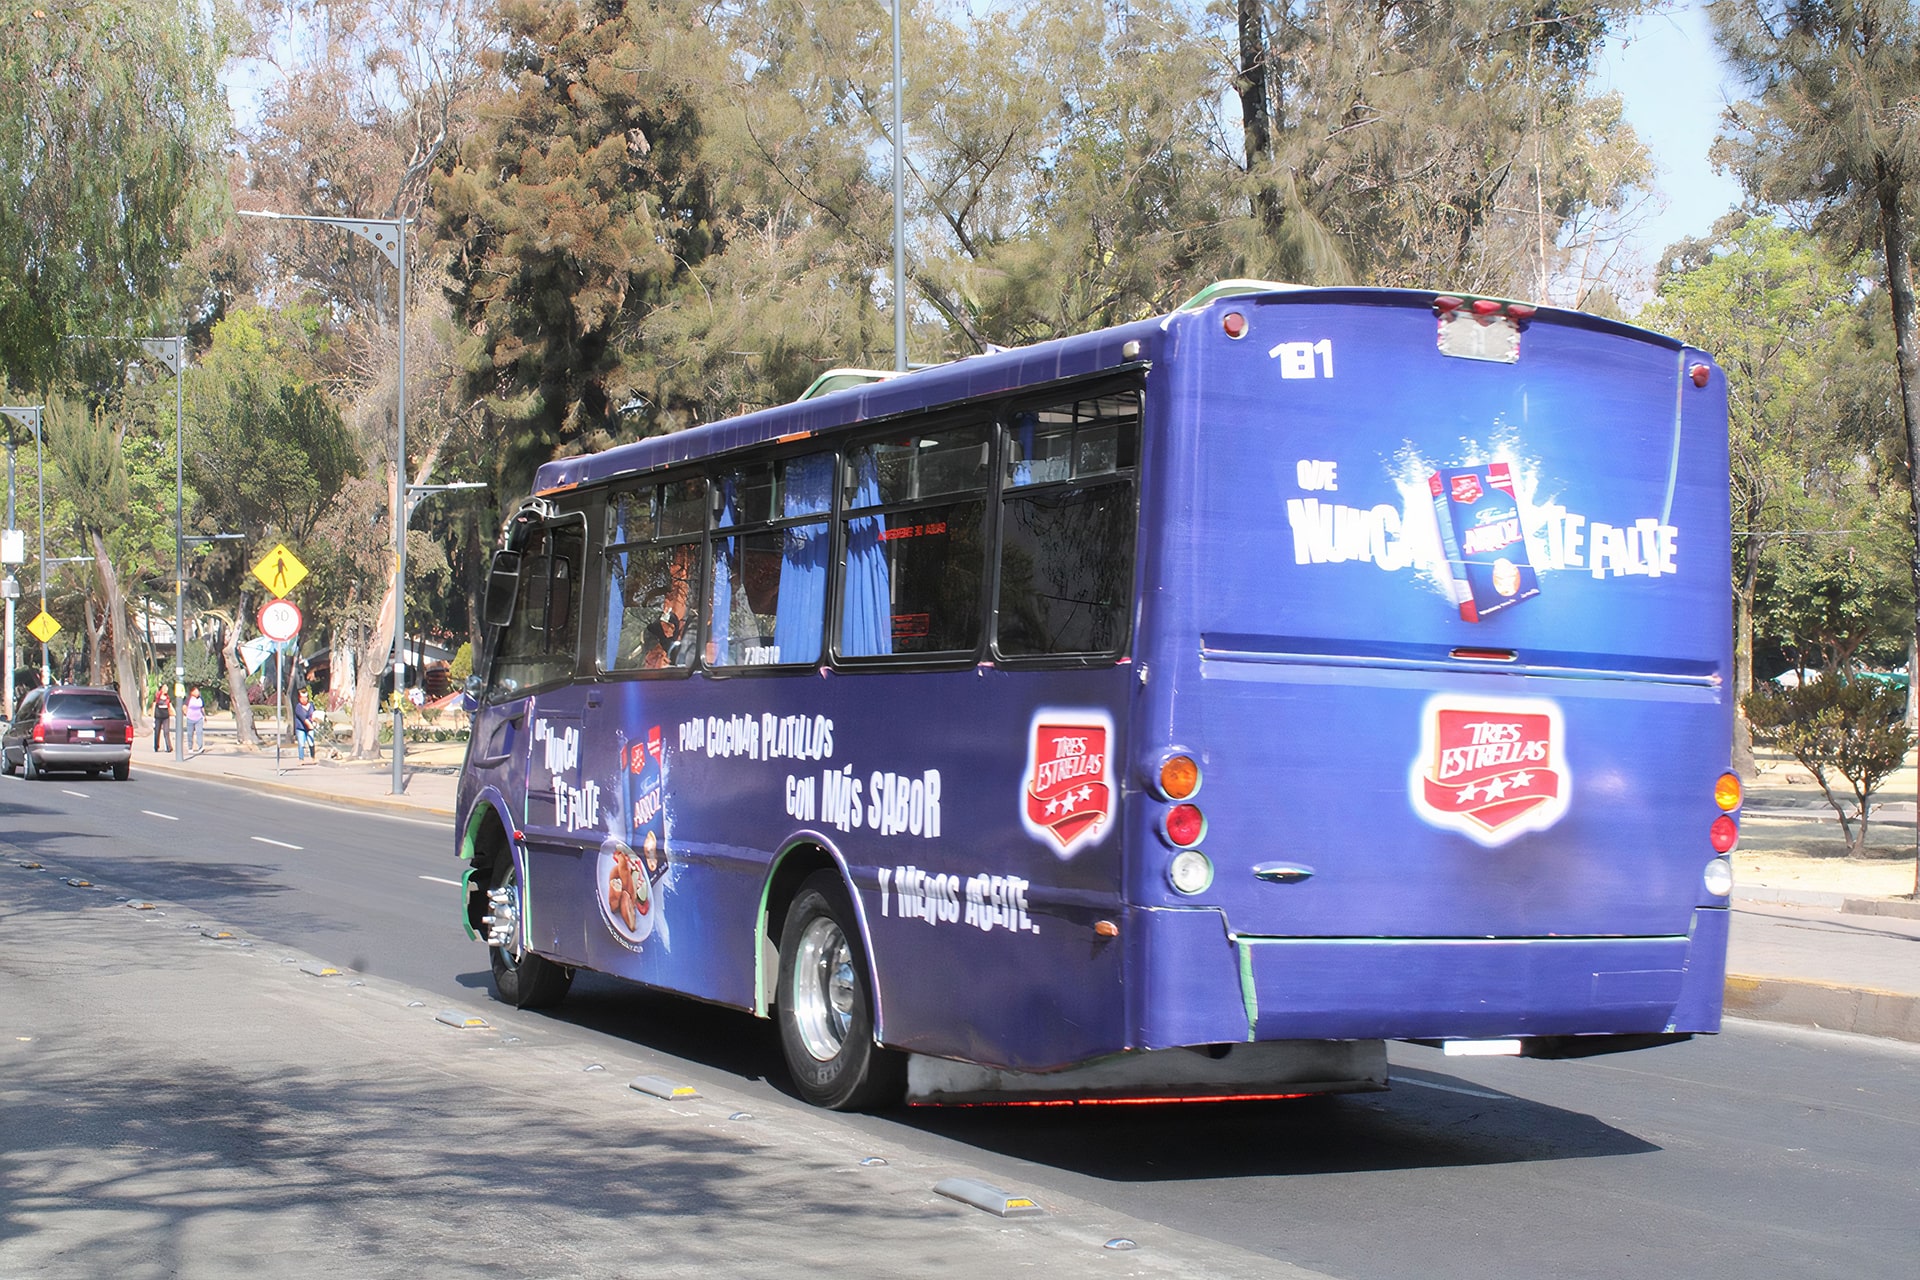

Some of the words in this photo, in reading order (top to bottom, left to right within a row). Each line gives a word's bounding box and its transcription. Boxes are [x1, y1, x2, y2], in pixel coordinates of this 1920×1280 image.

[1268, 338, 1334, 379] 181
[1296, 459, 1338, 491] QUE
[1543, 503, 1586, 570] TE
[1590, 518, 1678, 580] FALTE
[545, 726, 579, 775] NUNCA
[679, 717, 705, 753] PARA
[706, 713, 759, 760] COCINAR
[761, 712, 834, 762] PLATILLOS
[1051, 736, 1088, 759] TRES
[1463, 721, 1523, 745] TRES
[1036, 753, 1104, 792] ESTRELLAS
[1439, 740, 1549, 779] ESTRELLAS
[552, 775, 567, 827] TE
[567, 780, 600, 832] FALTE
[786, 774, 815, 821] CON
[821, 763, 863, 833] MÁS
[867, 769, 941, 838] SABOR
[878, 867, 892, 917] Y
[895, 865, 960, 926] MENOS
